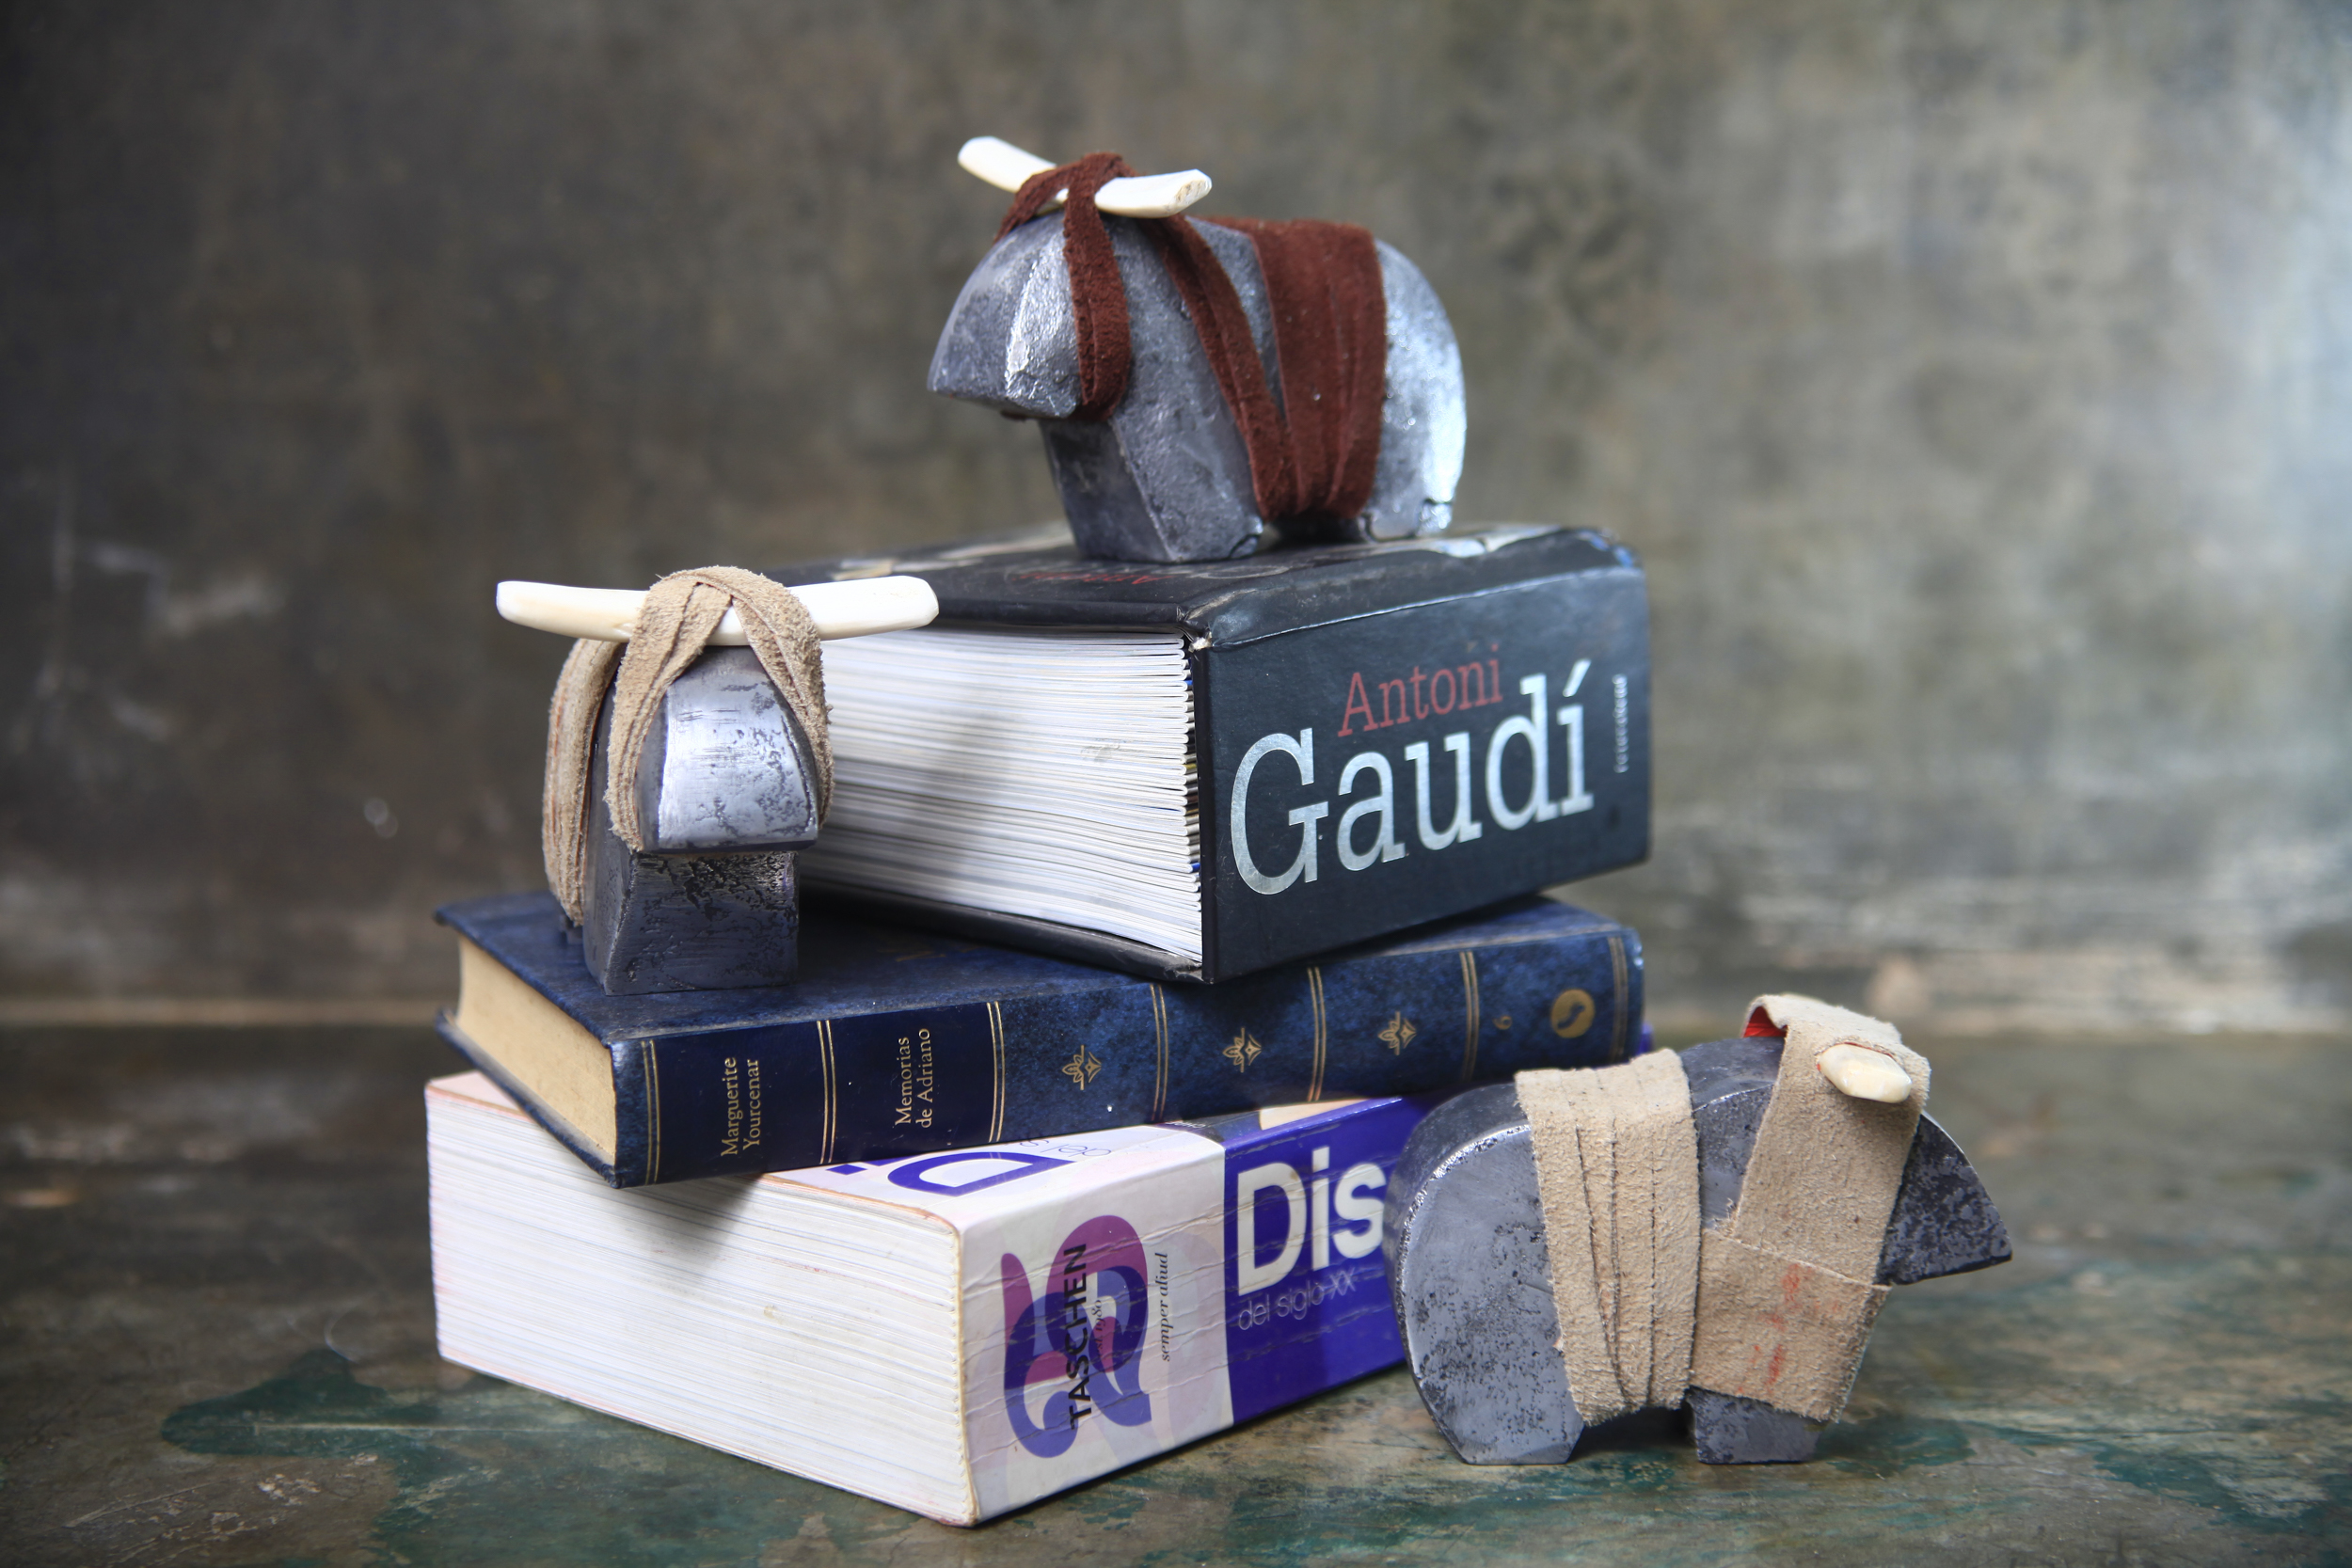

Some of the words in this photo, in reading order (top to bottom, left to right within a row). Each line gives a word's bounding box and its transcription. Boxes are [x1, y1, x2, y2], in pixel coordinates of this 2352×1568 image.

[1338, 644, 1503, 736] Antoni
[1231, 659, 1594, 895] Gaudí
[721, 1057, 743, 1156] Marguerite
[743, 1059, 761, 1151] Yourcenar
[895, 1037, 911, 1127] Memorias
[917, 1028, 933, 1101] Adriano
[916, 1106, 933, 1128] de
[1154, 1252, 1169, 1298] aliud
[1238, 1294, 1270, 1330] del
[1277, 1280, 1325, 1321] siglo
[1063, 1243, 1092, 1430] TASCHEN
[1158, 1300, 1174, 1363] semper
